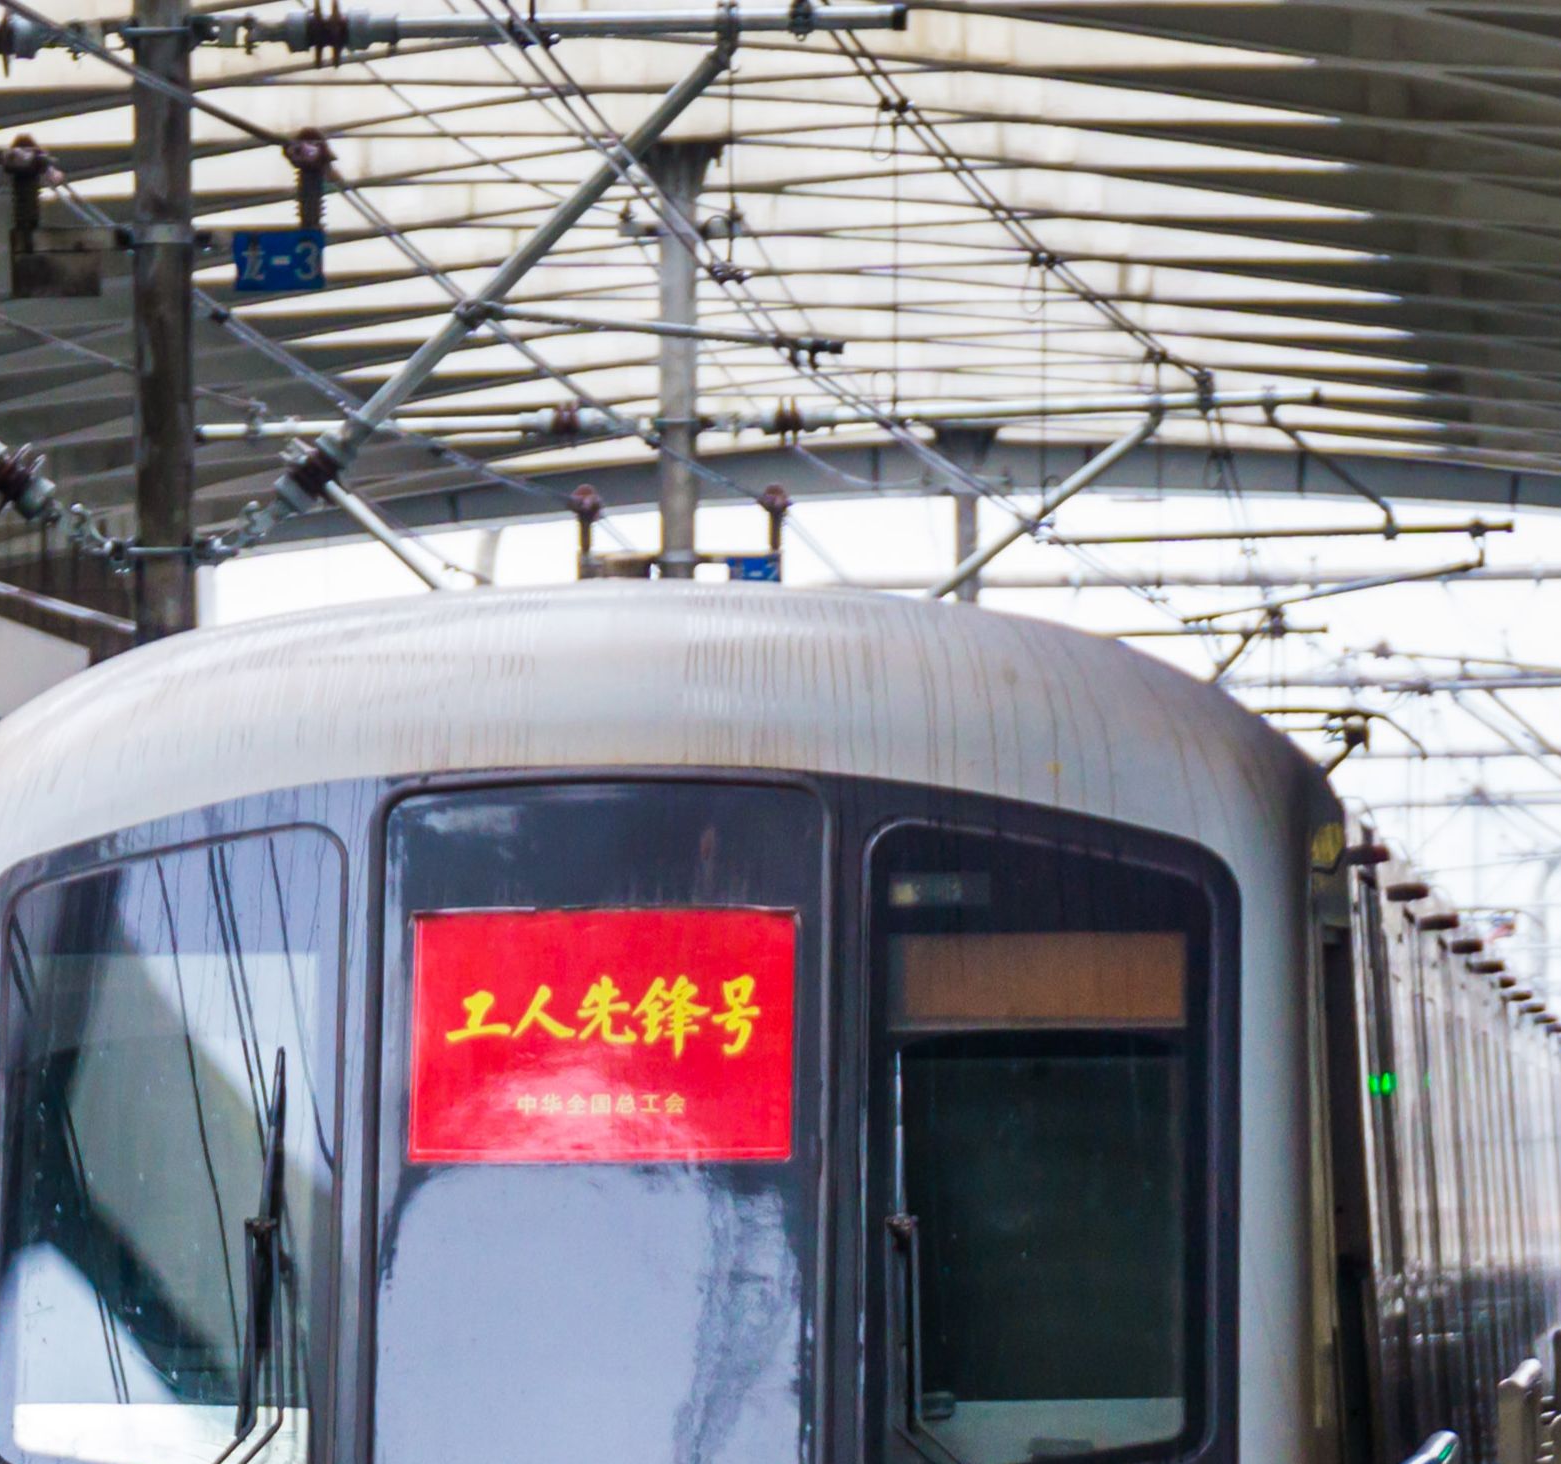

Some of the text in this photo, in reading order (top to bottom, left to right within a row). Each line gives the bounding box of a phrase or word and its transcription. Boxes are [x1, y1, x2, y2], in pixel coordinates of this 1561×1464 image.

[445, 974, 761, 1059] 工人先锋号
[515, 1092, 687, 1116] 中华全国总工会
